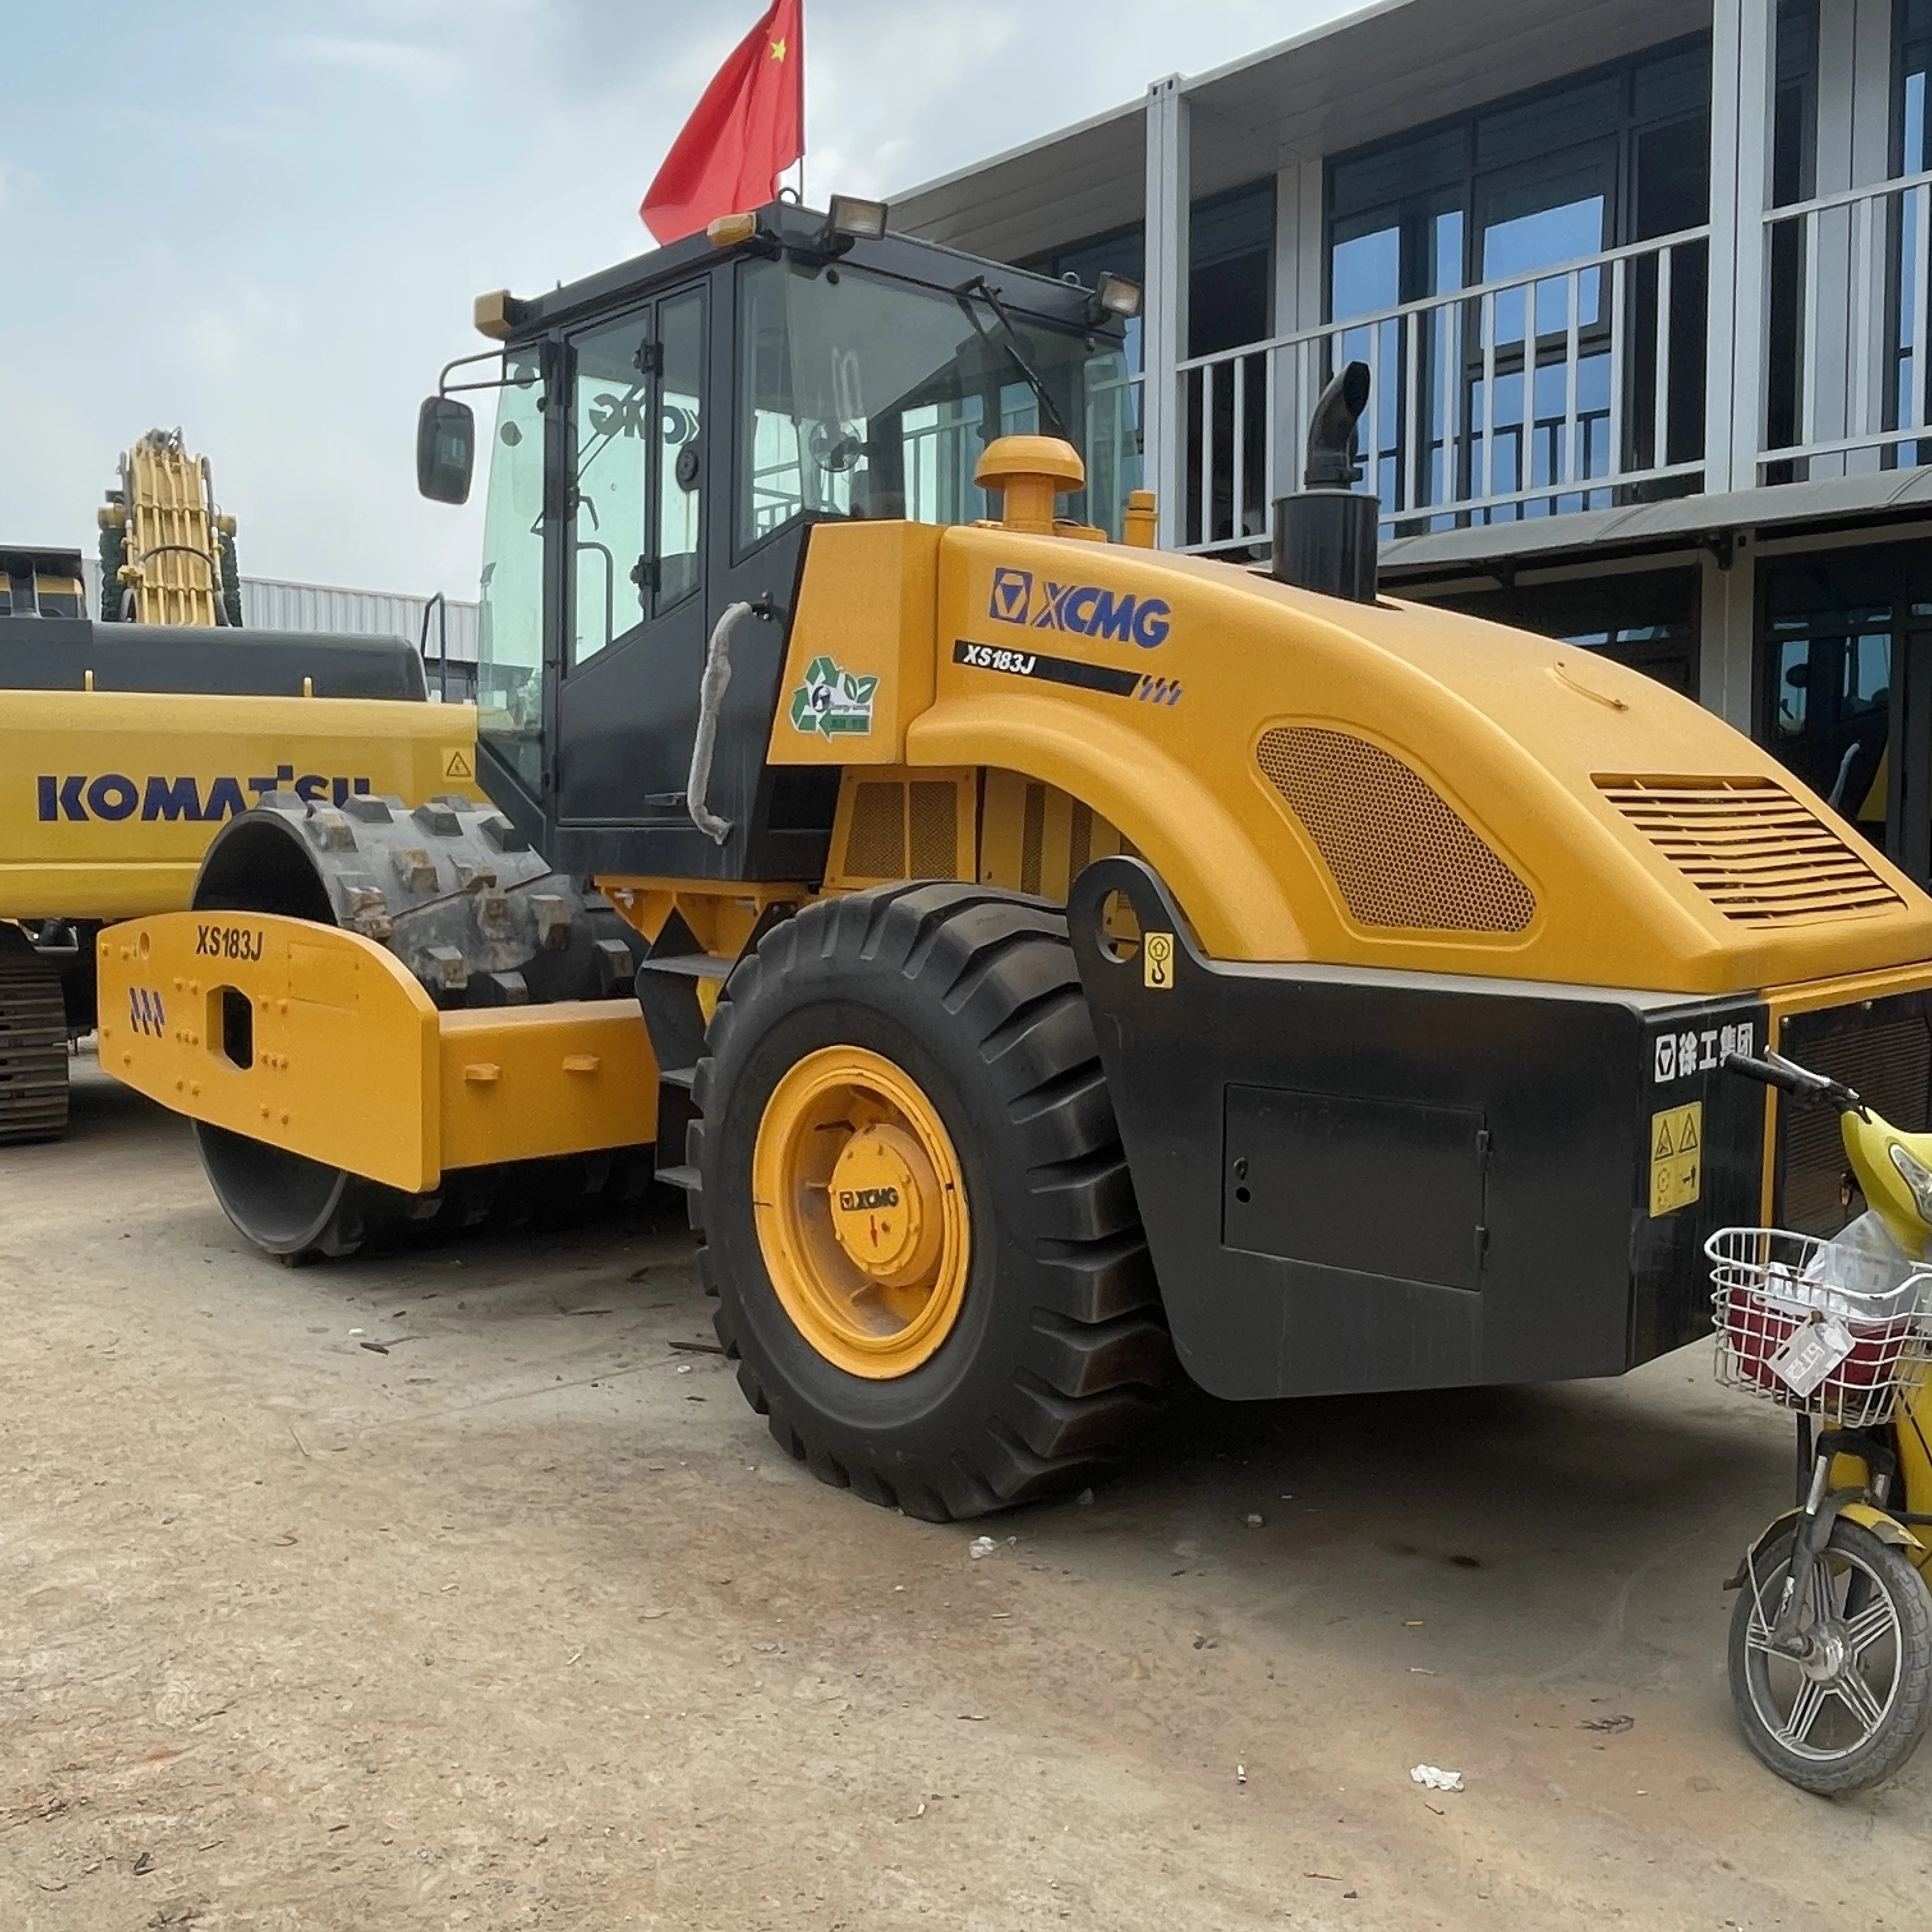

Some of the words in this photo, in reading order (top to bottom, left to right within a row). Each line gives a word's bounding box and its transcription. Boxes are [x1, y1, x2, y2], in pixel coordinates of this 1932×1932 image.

[1031, 581, 1171, 649] XCMG
[963, 645, 1036, 674] XS183J
[196, 925, 263, 961] XS183J
[1678, 1022, 1753, 1077] 徐工集团
